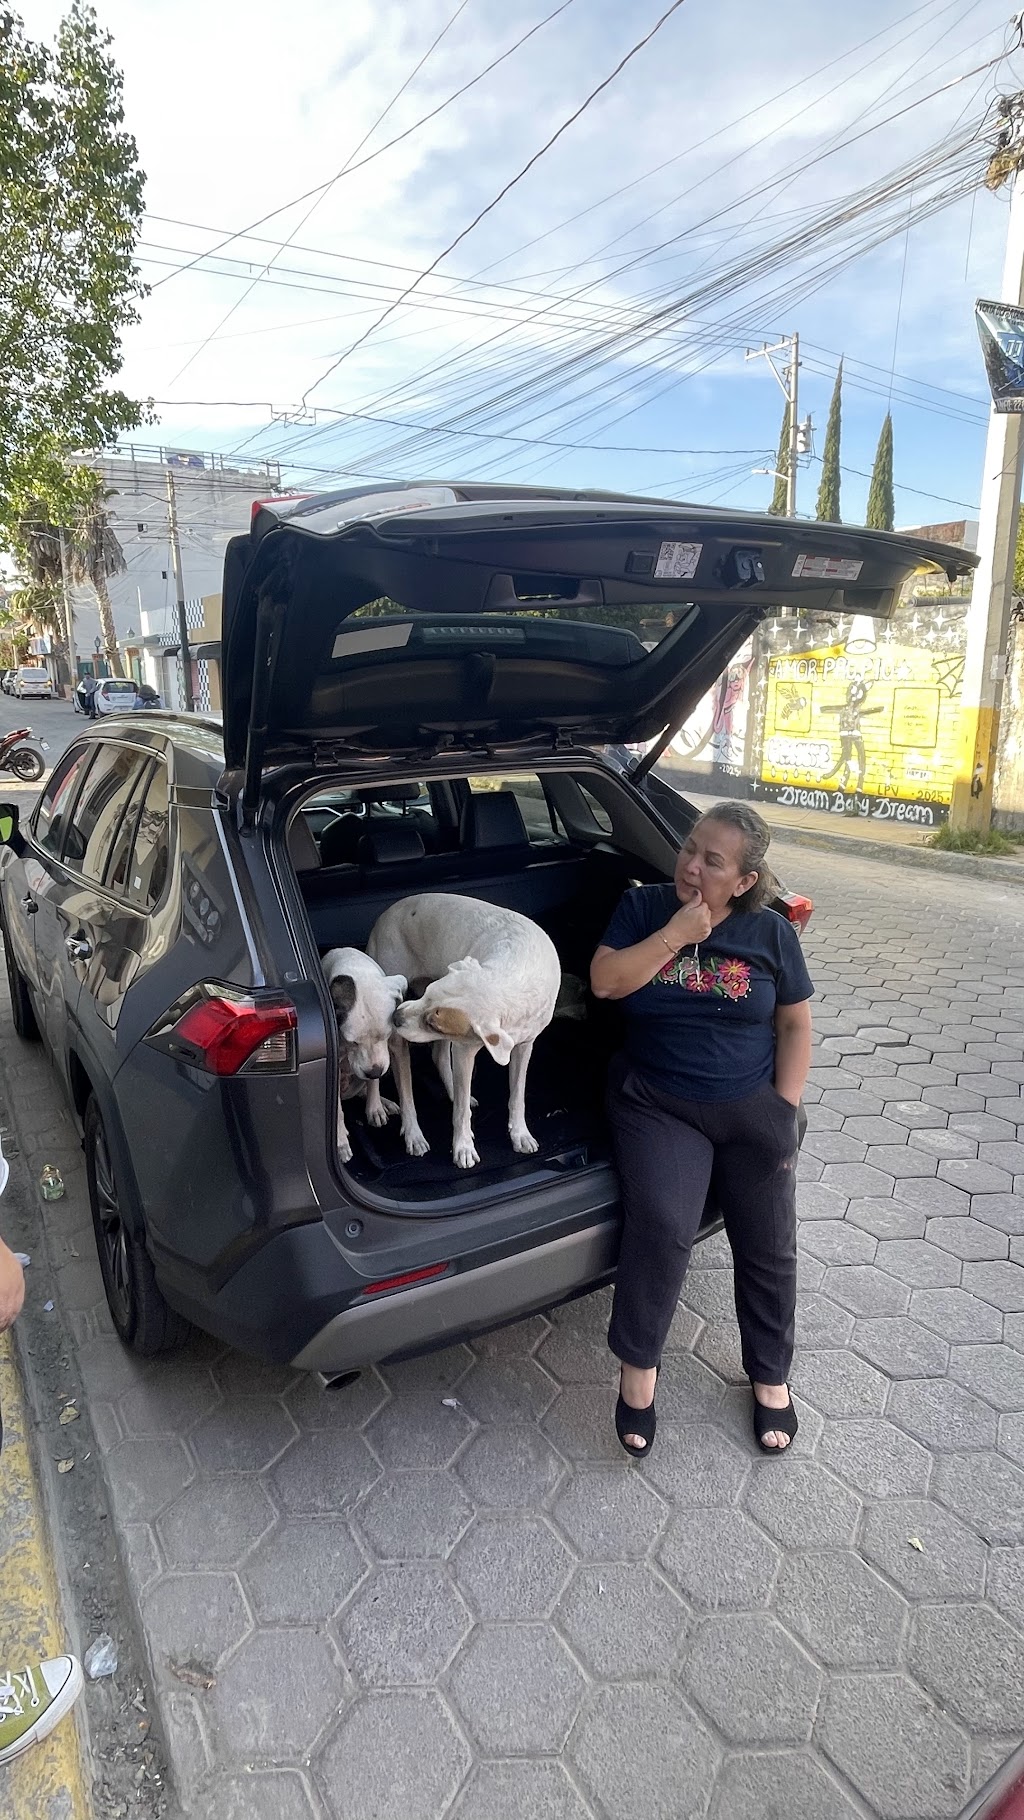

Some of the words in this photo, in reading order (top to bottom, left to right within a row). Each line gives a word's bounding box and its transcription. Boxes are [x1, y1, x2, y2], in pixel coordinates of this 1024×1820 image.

[774, 658, 818, 682] AMOR
[877, 784, 899, 797] LPV
[917, 789, 944, 803] 2025
[776, 786, 830, 810] Dream
[830, 791, 870, 817] Baby
[871, 797, 934, 825] Dream
